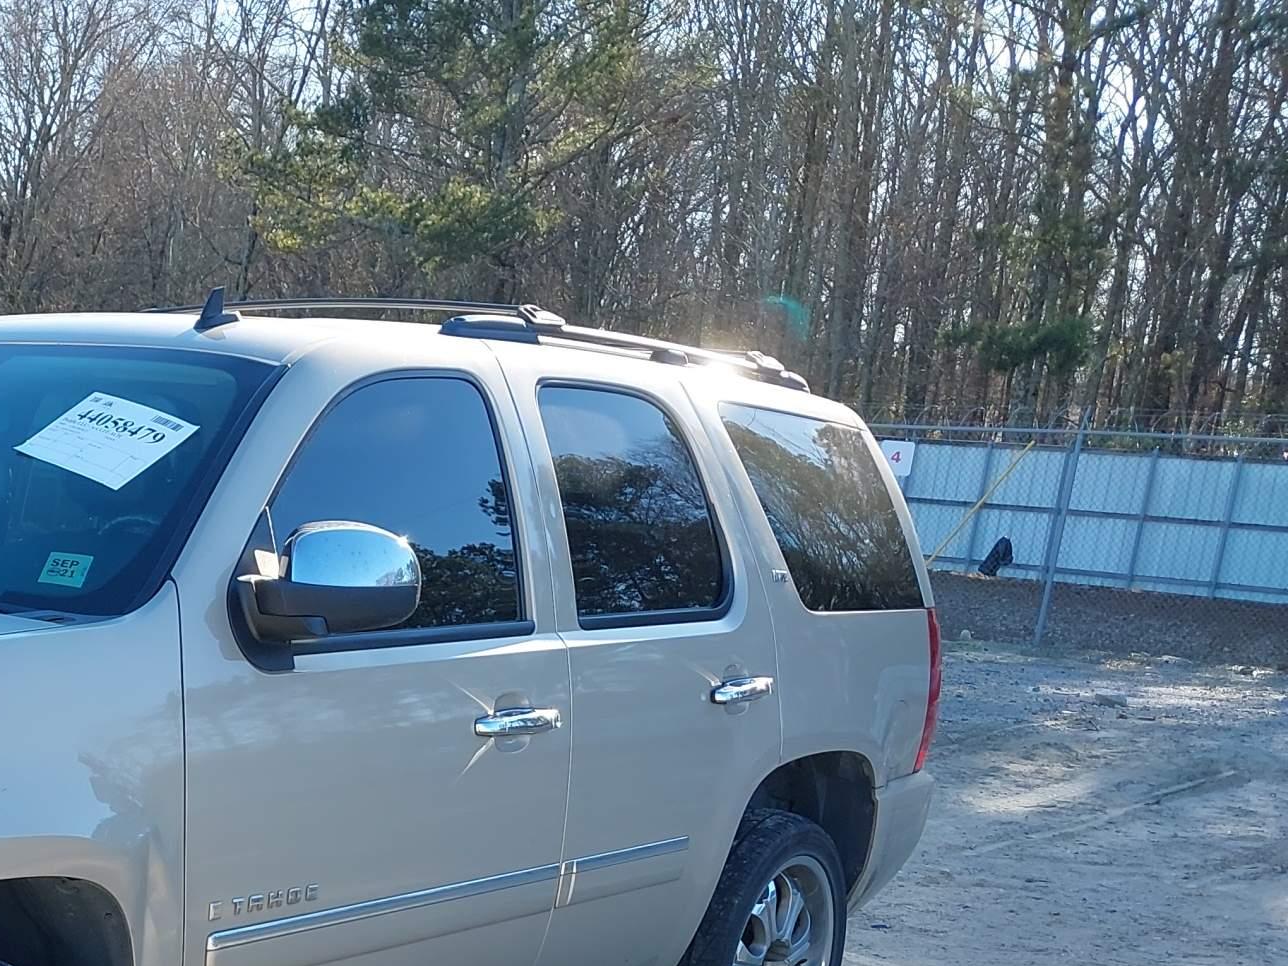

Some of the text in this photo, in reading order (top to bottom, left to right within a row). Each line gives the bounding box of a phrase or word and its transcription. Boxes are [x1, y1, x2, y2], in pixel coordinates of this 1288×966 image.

[77, 409, 166, 444] 44058479
[890, 451, 902, 463] 4
[50, 558, 80, 569] SEP
[232, 882, 319, 916] TAHOE
